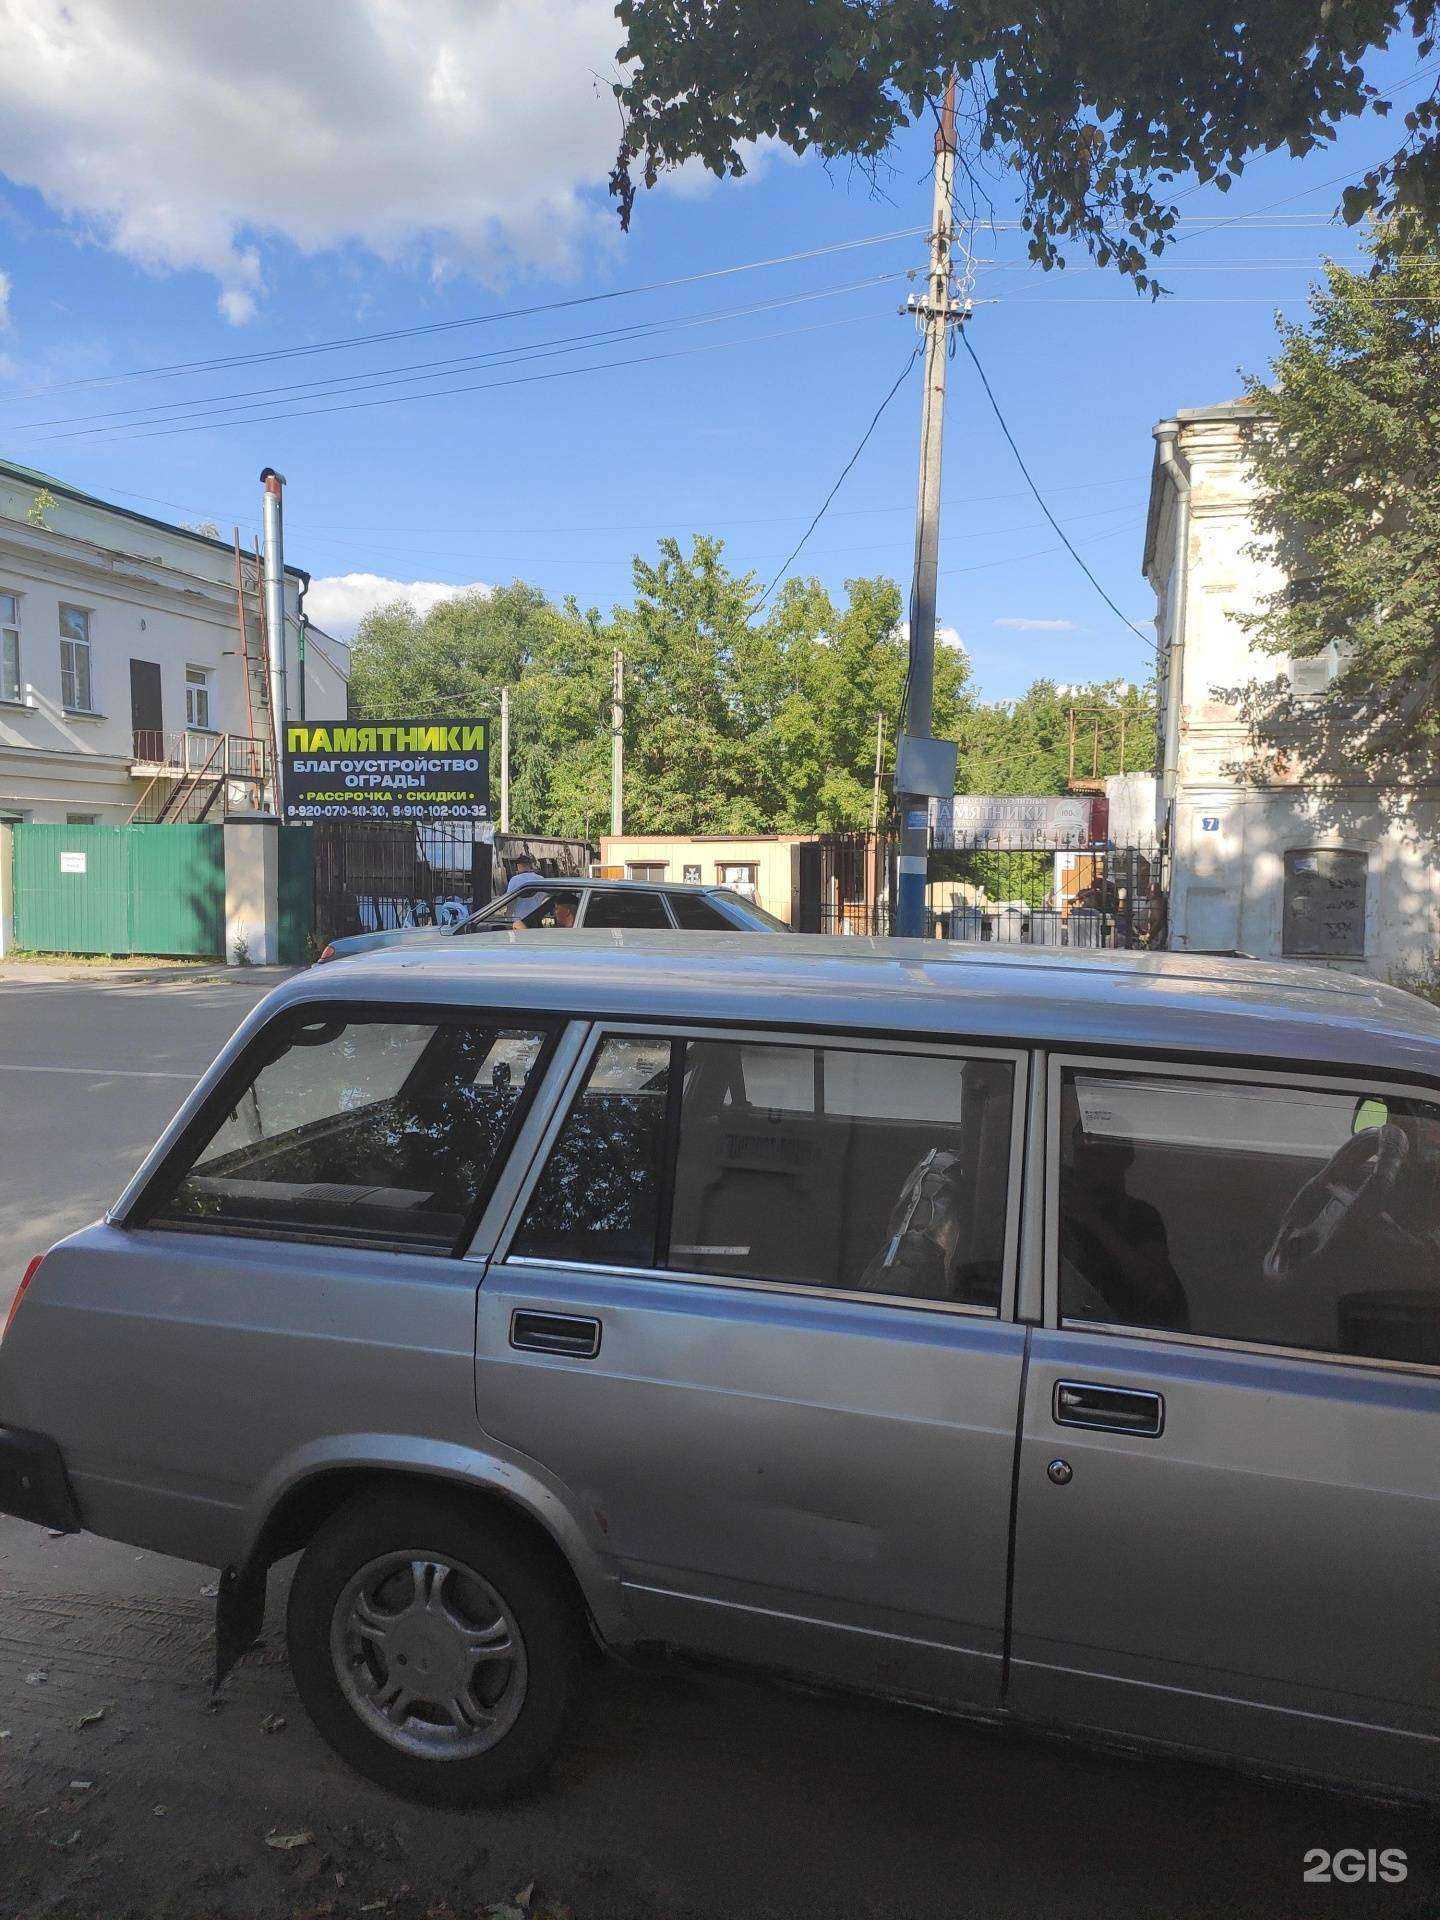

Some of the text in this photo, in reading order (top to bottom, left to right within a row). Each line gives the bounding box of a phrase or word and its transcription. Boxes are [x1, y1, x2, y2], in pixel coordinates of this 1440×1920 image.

[288, 726, 484, 752] ПАМЯТНИКИ
[293, 757, 479, 772] БЛАГОУСТРОЙСТВО
[345, 774, 426, 788] ОГРАДЫ
[306, 791, 467, 802] РАССРОЧКА СКИДКИ
[393, 804, 487, 817] 8-910-102-00-32
[1206, 819, 1215, 829] 7
